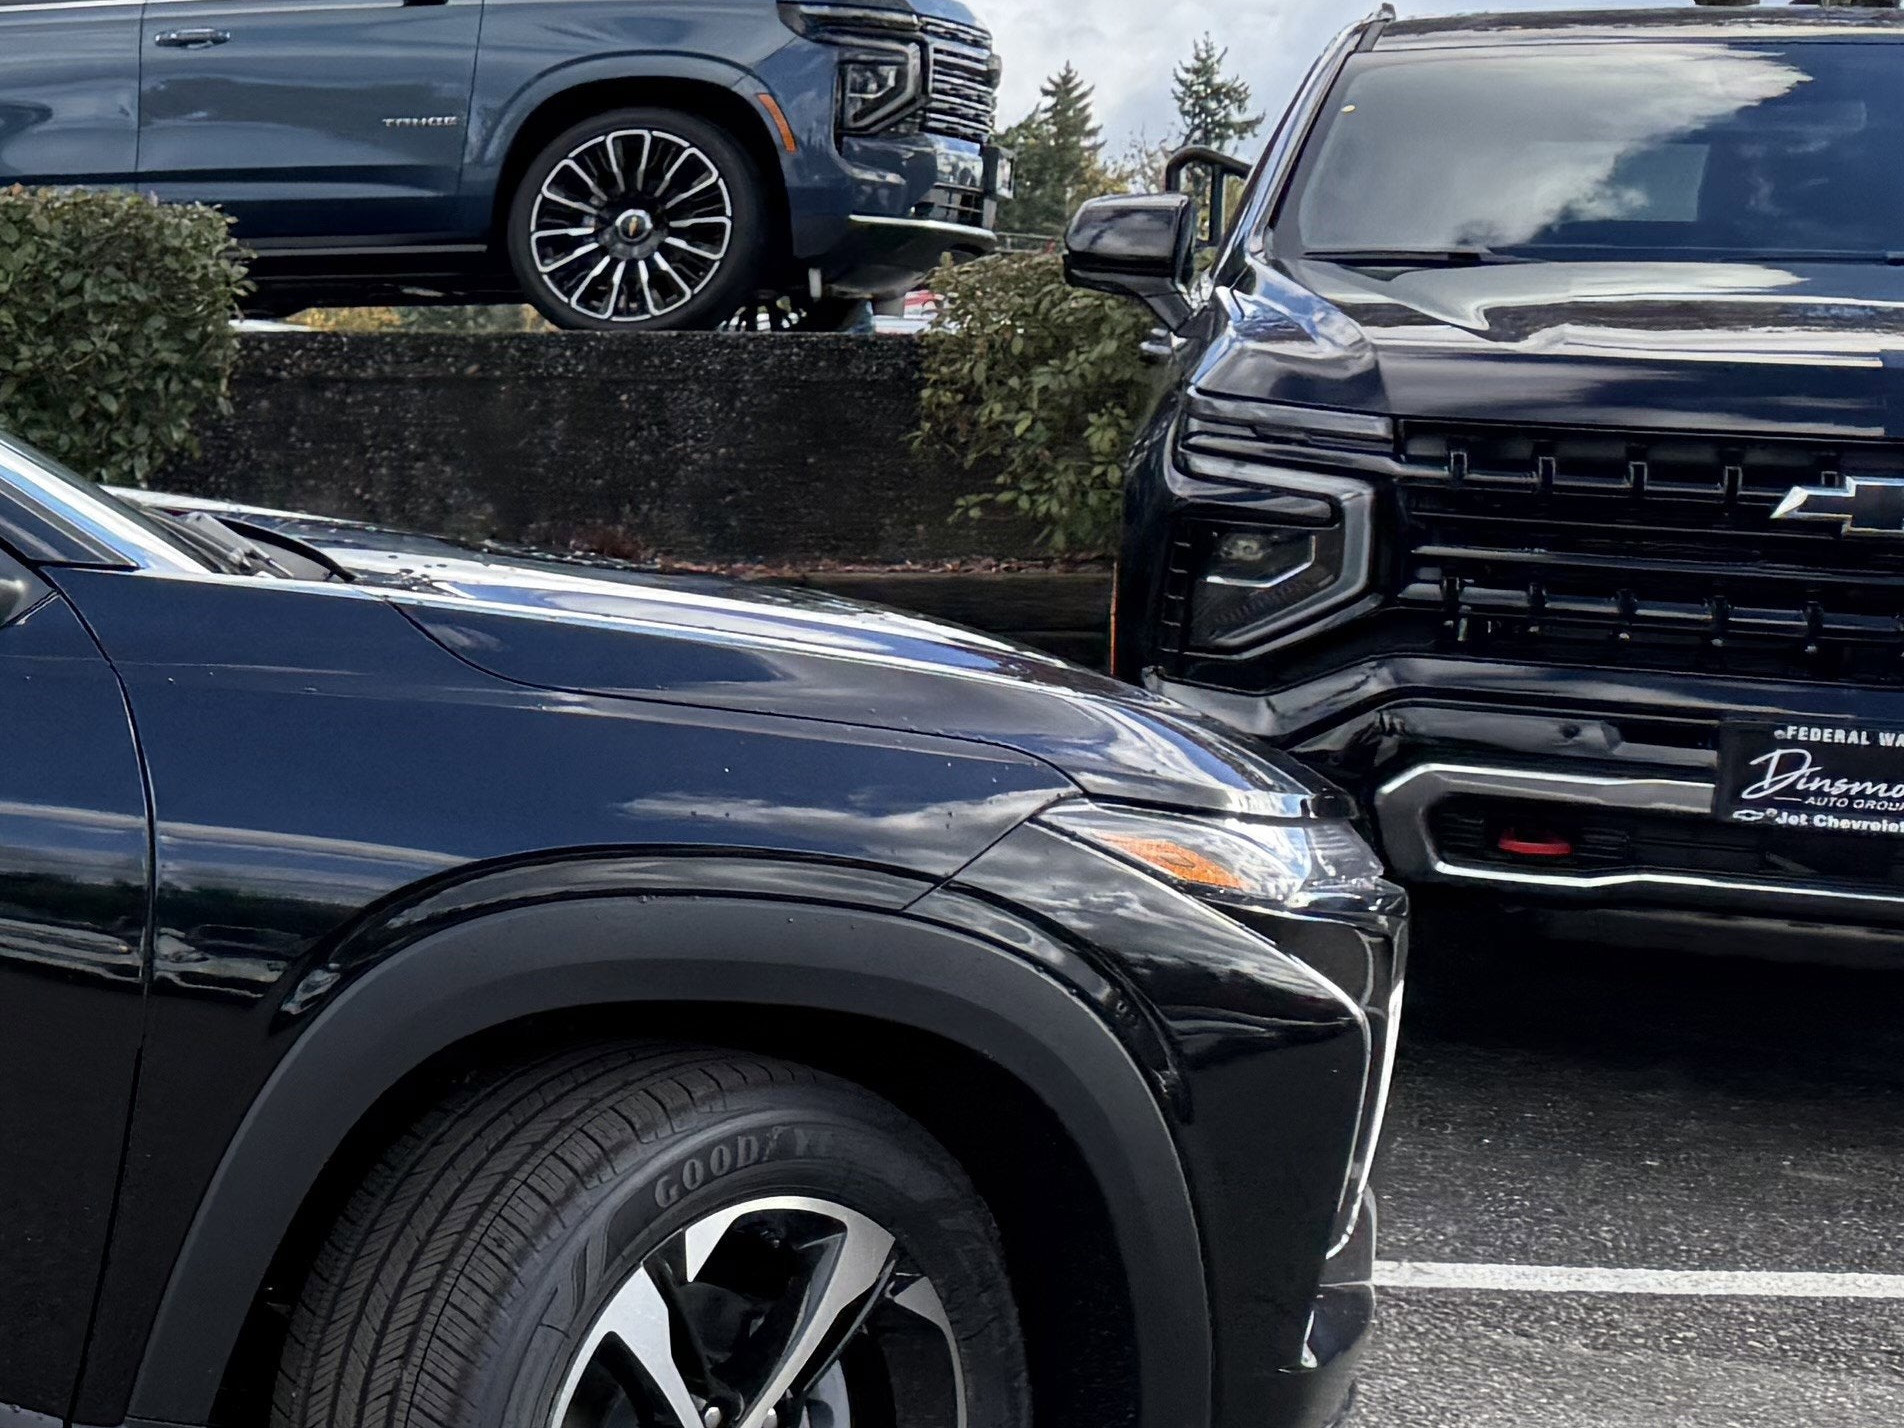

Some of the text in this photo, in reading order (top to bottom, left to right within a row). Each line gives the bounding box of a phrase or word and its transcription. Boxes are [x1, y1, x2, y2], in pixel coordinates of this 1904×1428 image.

[1786, 725, 1870, 745] FEDERAL
[1805, 796, 1849, 807] AUTO
[1775, 812, 1808, 825] Jet
